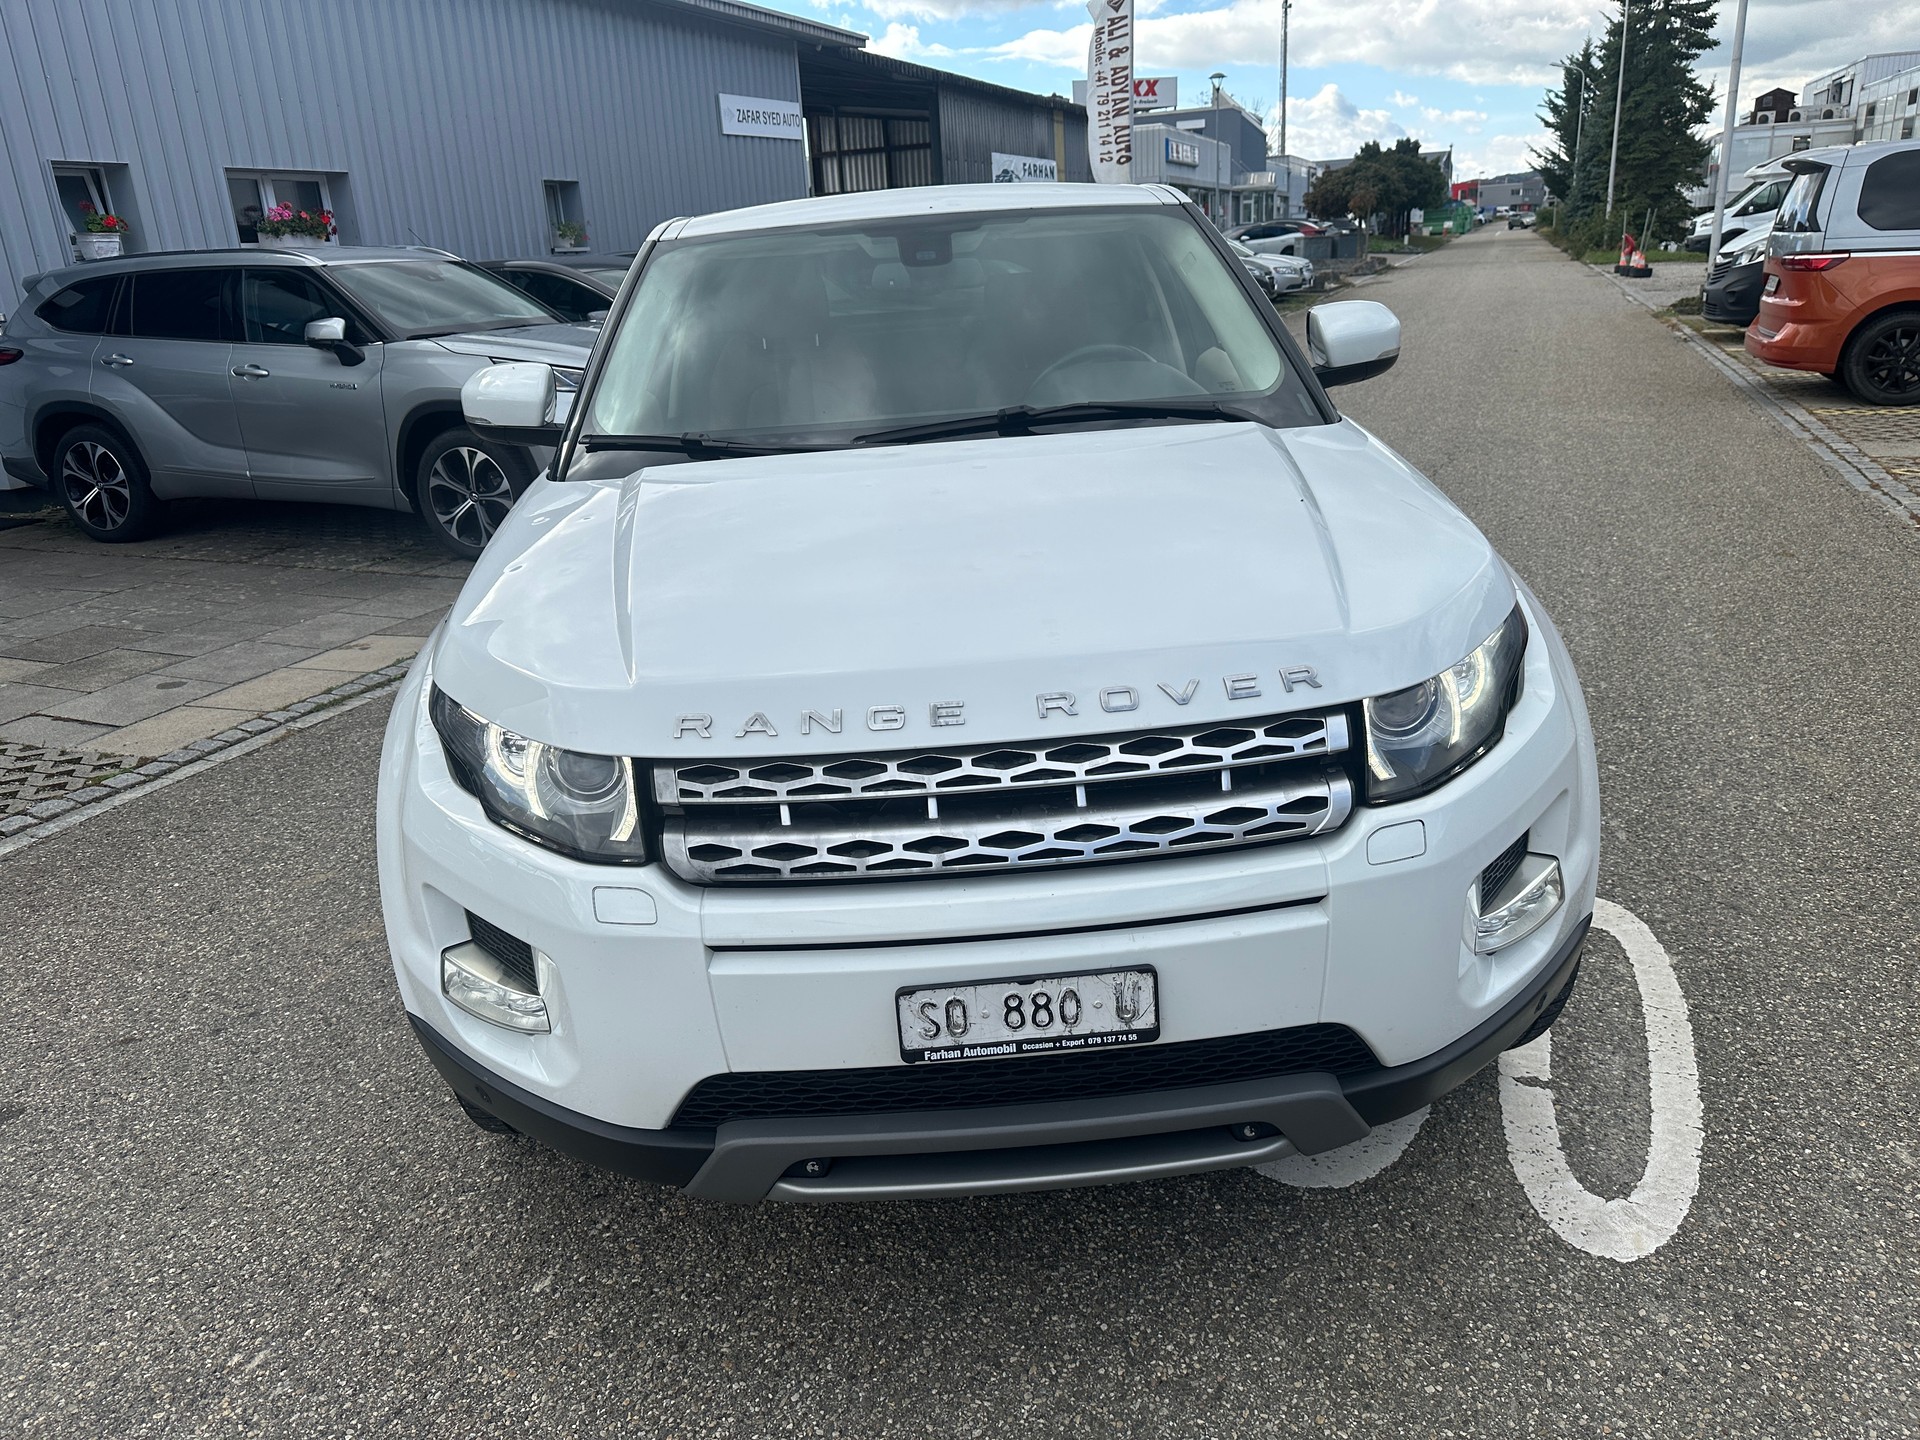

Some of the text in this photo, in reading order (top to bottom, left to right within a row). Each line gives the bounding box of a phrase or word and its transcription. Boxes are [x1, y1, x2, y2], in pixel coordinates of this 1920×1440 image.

[736, 108, 800, 127] ZAFAR SYED AUTO
[1095, 26, 1114, 164] Mobile: +41 79 211 14 12
[1107, 14, 1133, 165] ALI & ADYAN AUTO
[1022, 162, 1055, 180] FARHAN
[673, 664, 1323, 739] RANGE ROVER
[917, 978, 1141, 1040] SO 880 U
[924, 1050, 961, 1061] Farhan
[963, 1043, 1017, 1058] Automobil
[1022, 1041, 1054, 1051] Occasion
[1062, 1038, 1085, 1048] Export
[1088, 1036, 1101, 1045] 079
[1103, 1035, 1116, 1043] 137
[1117, 1034, 1127, 1042] 74
[1128, 1033, 1138, 1041] 55
